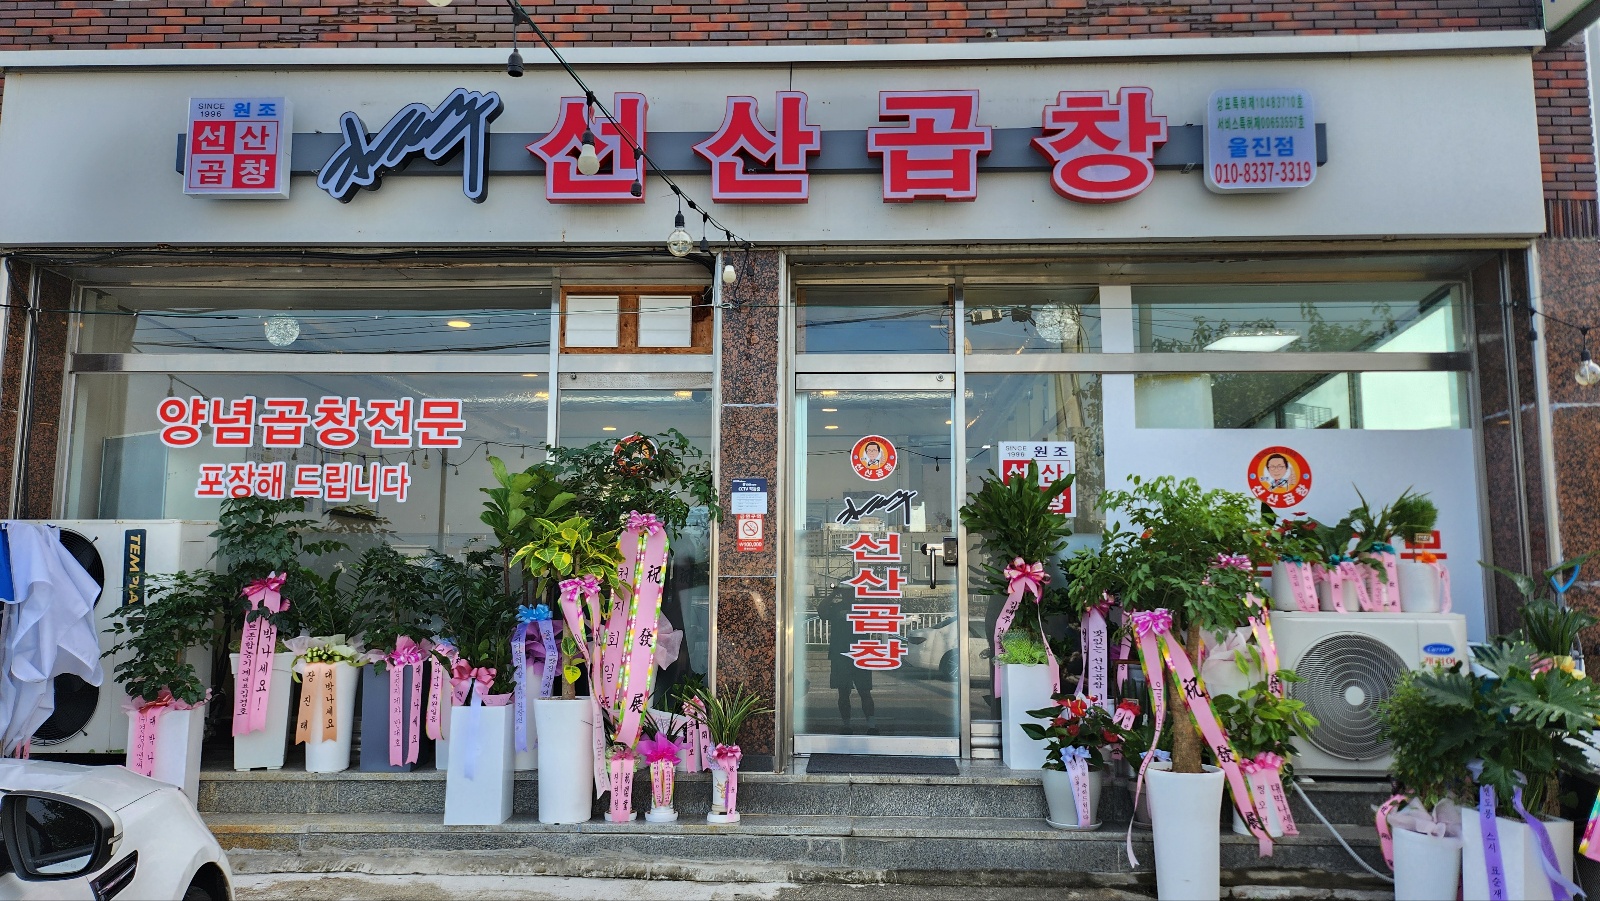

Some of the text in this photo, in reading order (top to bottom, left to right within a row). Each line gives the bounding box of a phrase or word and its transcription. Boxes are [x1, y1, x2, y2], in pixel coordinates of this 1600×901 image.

[198, 102, 226, 111] SINCE
[200, 110, 223, 119] 1996
[233, 101, 277, 119] 원조
[526, 87, 1168, 205] 선산곱창
[1228, 136, 1294, 158] 울진점
[1215, 161, 1312, 184] 010-8337-3319
[157, 395, 467, 449] 양념곱창전문
[1033, 445, 1069, 458] 원조
[195, 461, 412, 503] 포장해 드립니다
[854, 462, 894, 479] 선산곱창
[1251, 483, 1309, 506] 선산곱창
[841, 532, 909, 671] 선산곱창
[1426, 645, 1451, 654] Carrier
[1091, 657, 1105, 690] 선산곱창
[324, 668, 335, 730] 대박나세요
[1271, 782, 1294, 832] 대박나세요
